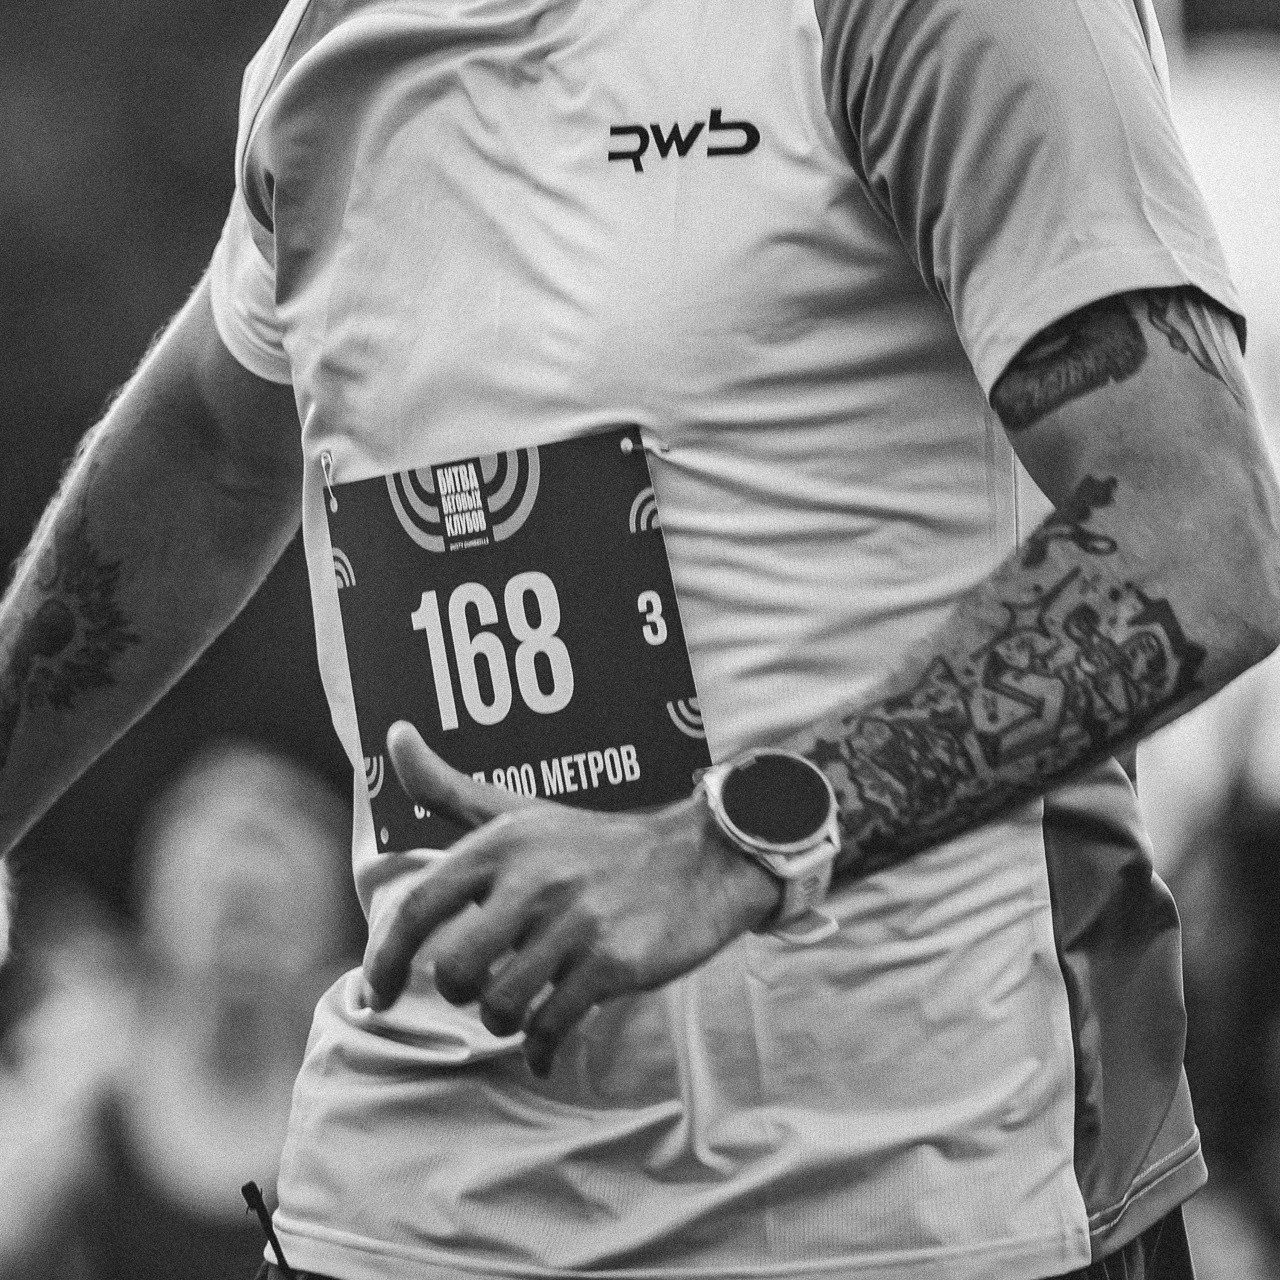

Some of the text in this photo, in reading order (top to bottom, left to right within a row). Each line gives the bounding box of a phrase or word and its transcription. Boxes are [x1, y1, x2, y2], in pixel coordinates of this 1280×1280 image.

[637, 590, 668, 646] 3
[411, 571, 575, 732] 168
[540, 744, 641, 797] МЕТРОВ
